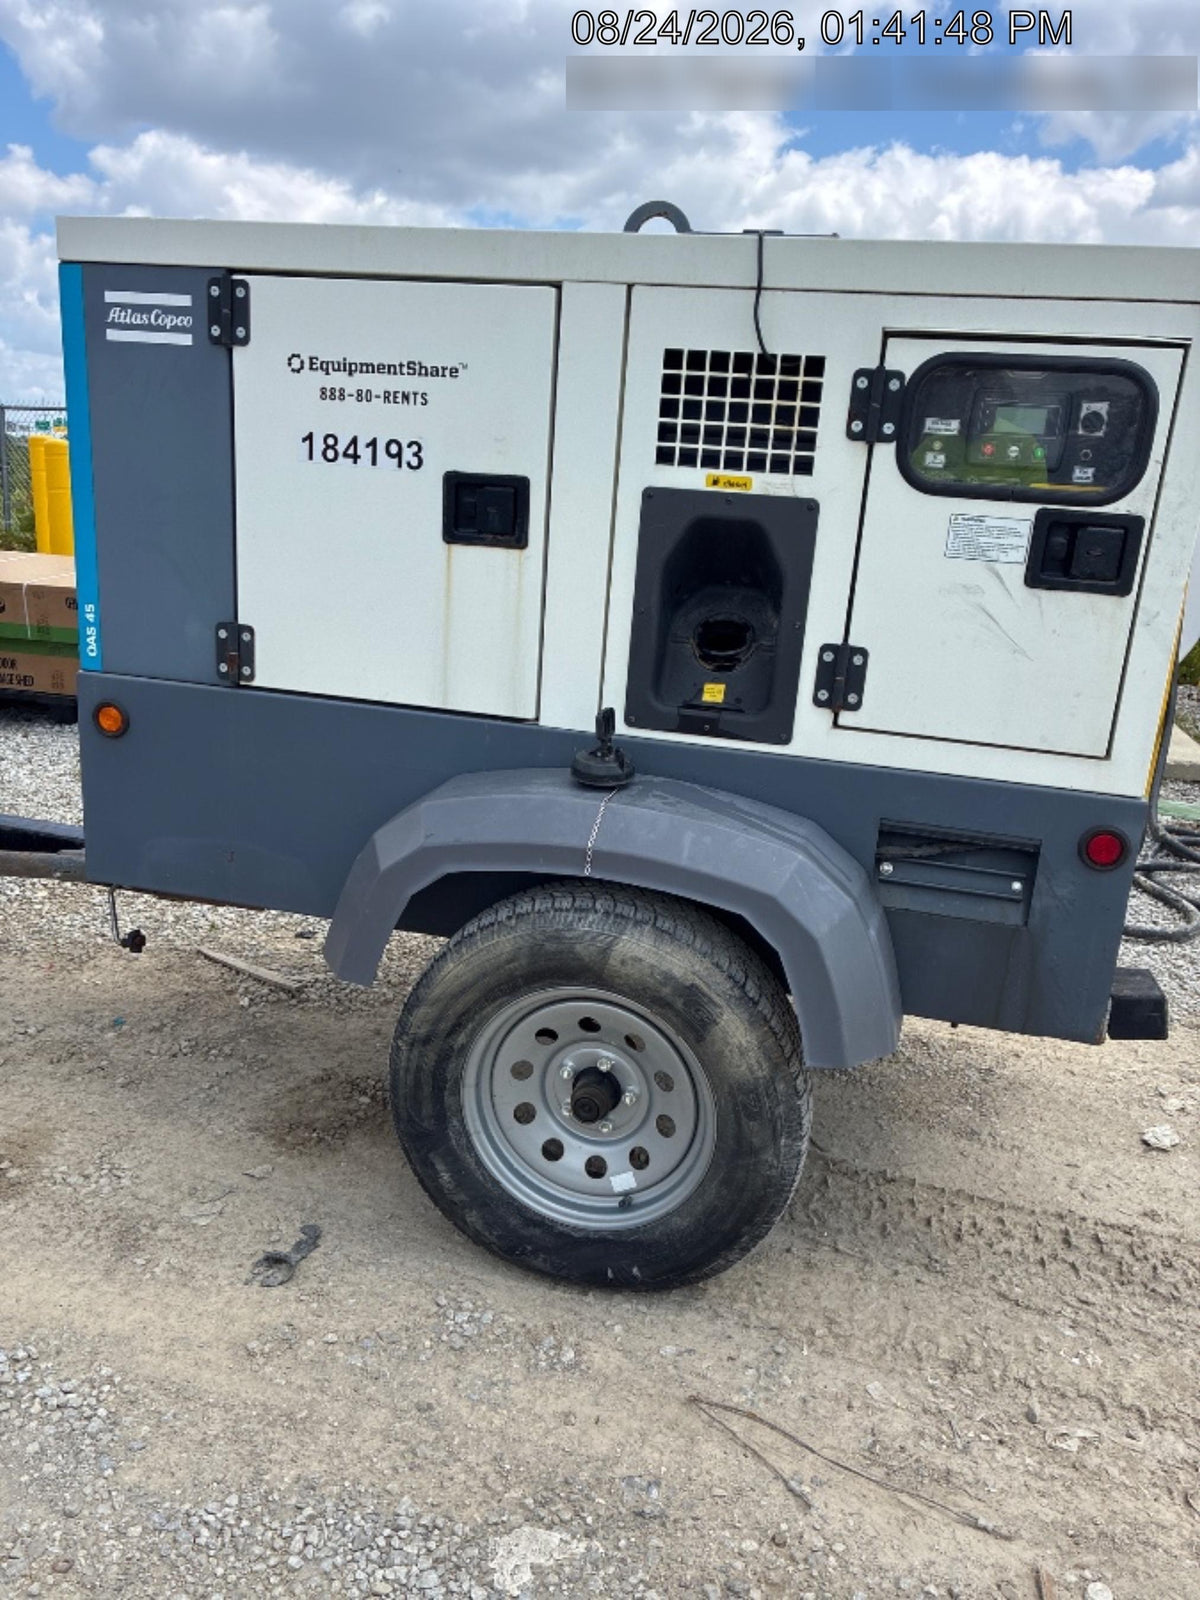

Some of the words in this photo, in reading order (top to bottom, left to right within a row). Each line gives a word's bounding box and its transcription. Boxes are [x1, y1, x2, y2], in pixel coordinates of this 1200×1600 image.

[106, 306, 149, 325] Atlas
[150, 308, 192, 329] Copco
[319, 386, 429, 406] 888-80-RENTS
[301, 431, 424, 471] 184193
[84, 604, 95, 623] 45
